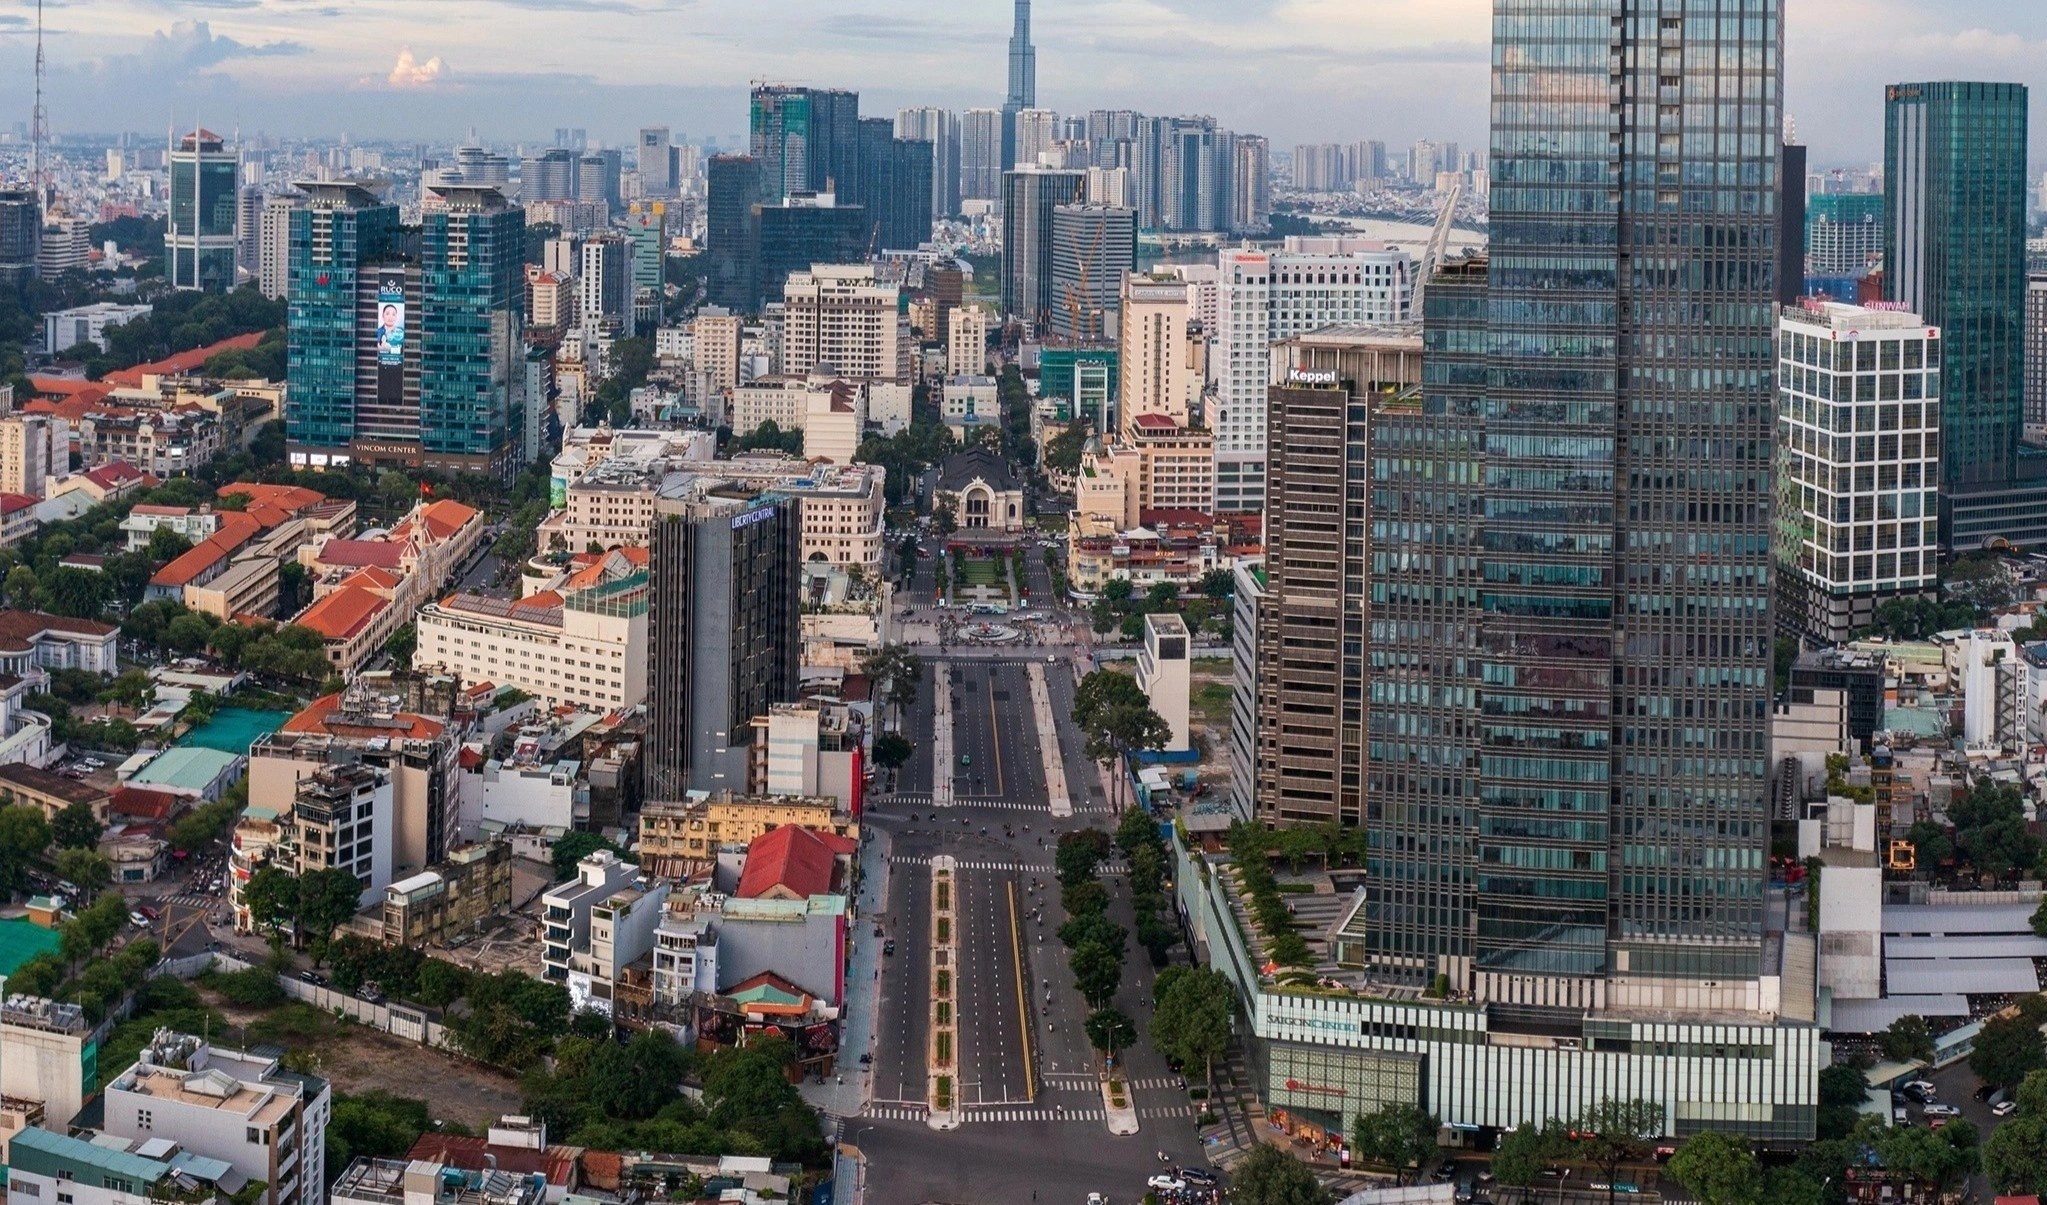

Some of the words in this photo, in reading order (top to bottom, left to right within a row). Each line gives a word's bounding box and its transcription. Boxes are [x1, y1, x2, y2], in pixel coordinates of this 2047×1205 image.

[1864, 302, 1910, 311] SUNWAH
[1290, 369, 1336, 383] Keppel
[356, 444, 387, 453] VINCOM
[388, 446, 417, 455] CENTER
